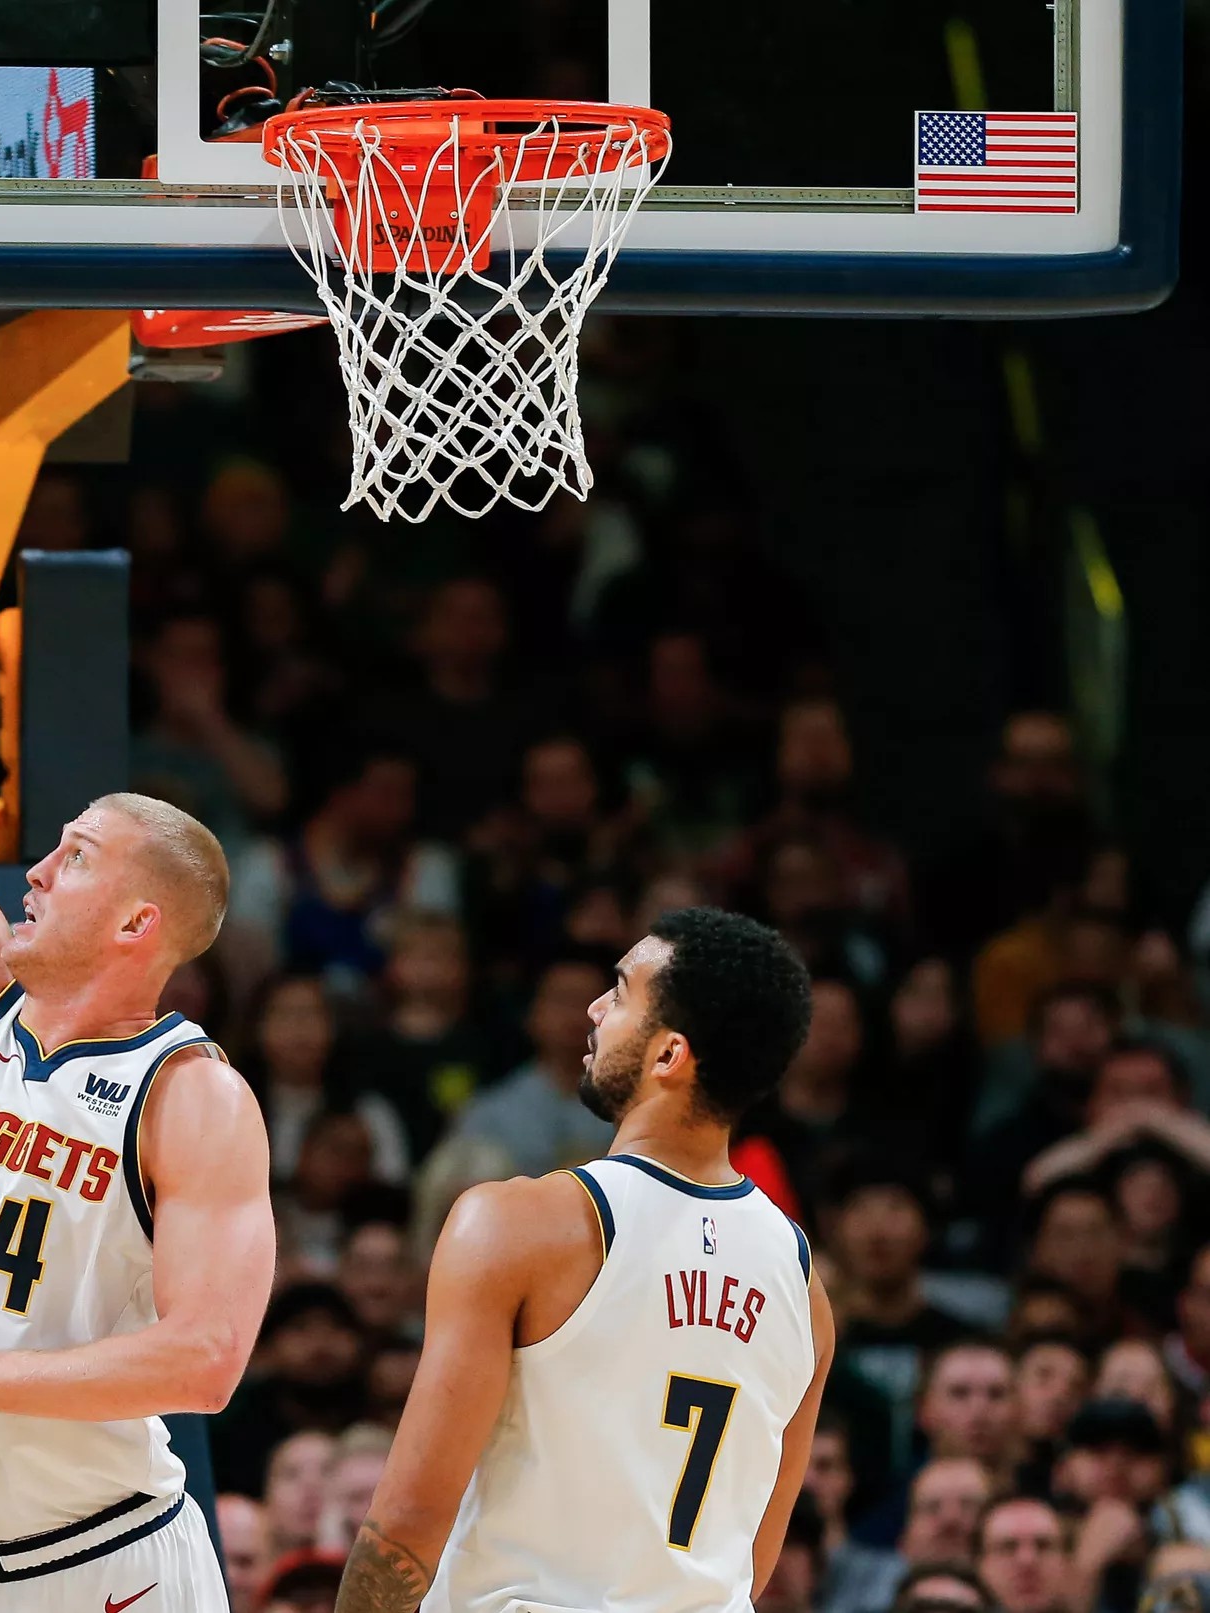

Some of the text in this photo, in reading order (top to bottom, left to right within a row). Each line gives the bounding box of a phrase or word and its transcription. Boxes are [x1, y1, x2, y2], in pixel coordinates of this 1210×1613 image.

[76, 1092, 122, 1111] WESTERN
[84, 1071, 132, 1104] WU
[87, 1104, 120, 1118] UNION
[664, 1269, 767, 1344] LYLES
[660, 1369, 742, 1552] 7
